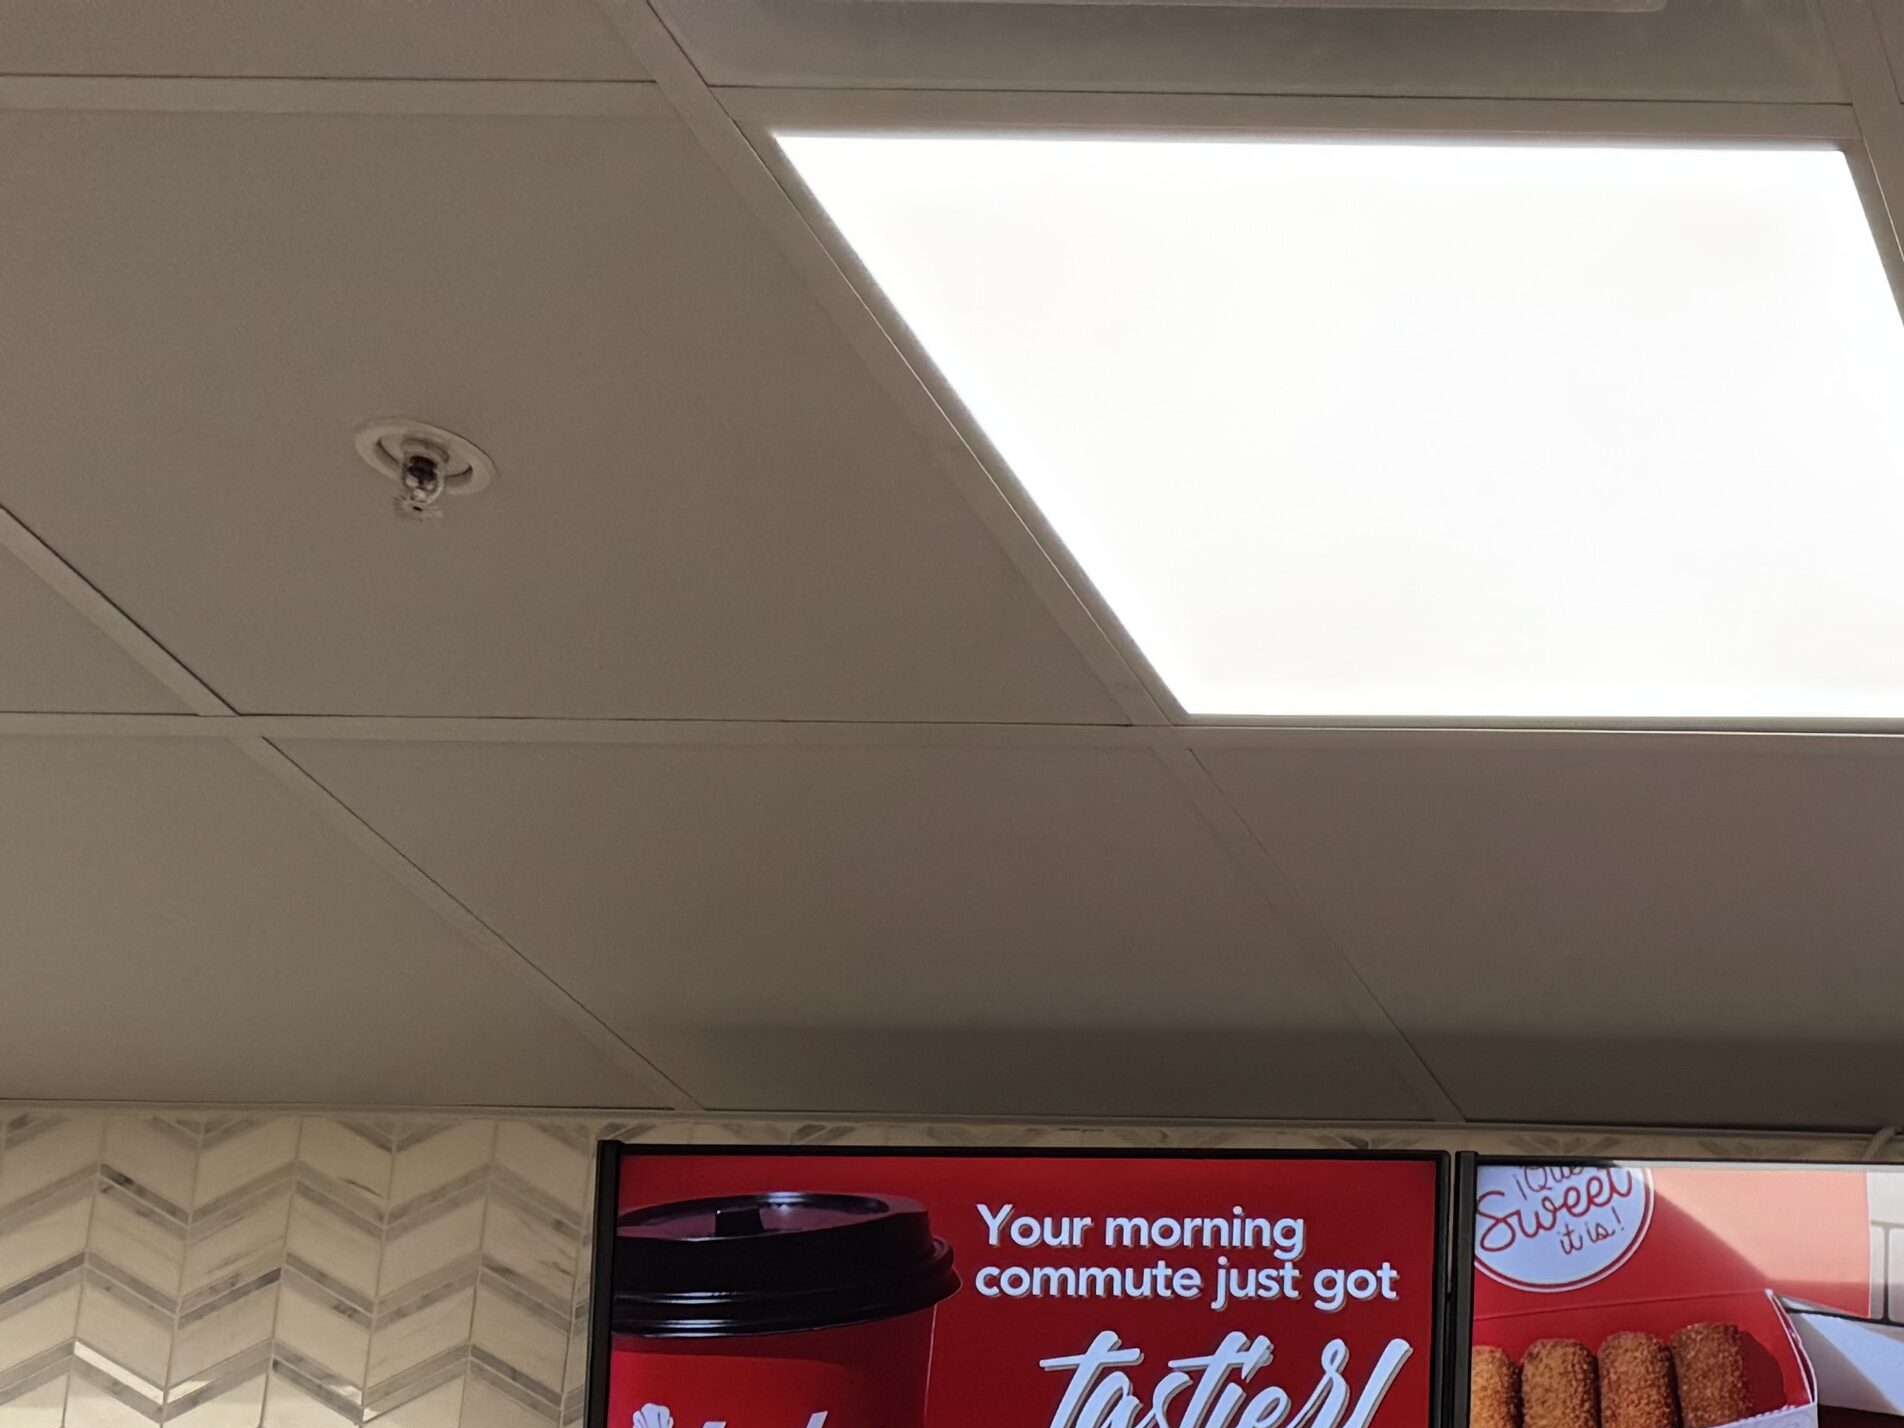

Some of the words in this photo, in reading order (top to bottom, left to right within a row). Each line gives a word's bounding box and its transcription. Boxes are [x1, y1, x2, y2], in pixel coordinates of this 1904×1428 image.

[977, 1204, 1093, 1247] Your
[1106, 1206, 1303, 1261] morning
[976, 1261, 1201, 1297] commute
[1211, 1262, 1301, 1309] just
[1314, 1262, 1399, 1310] got
